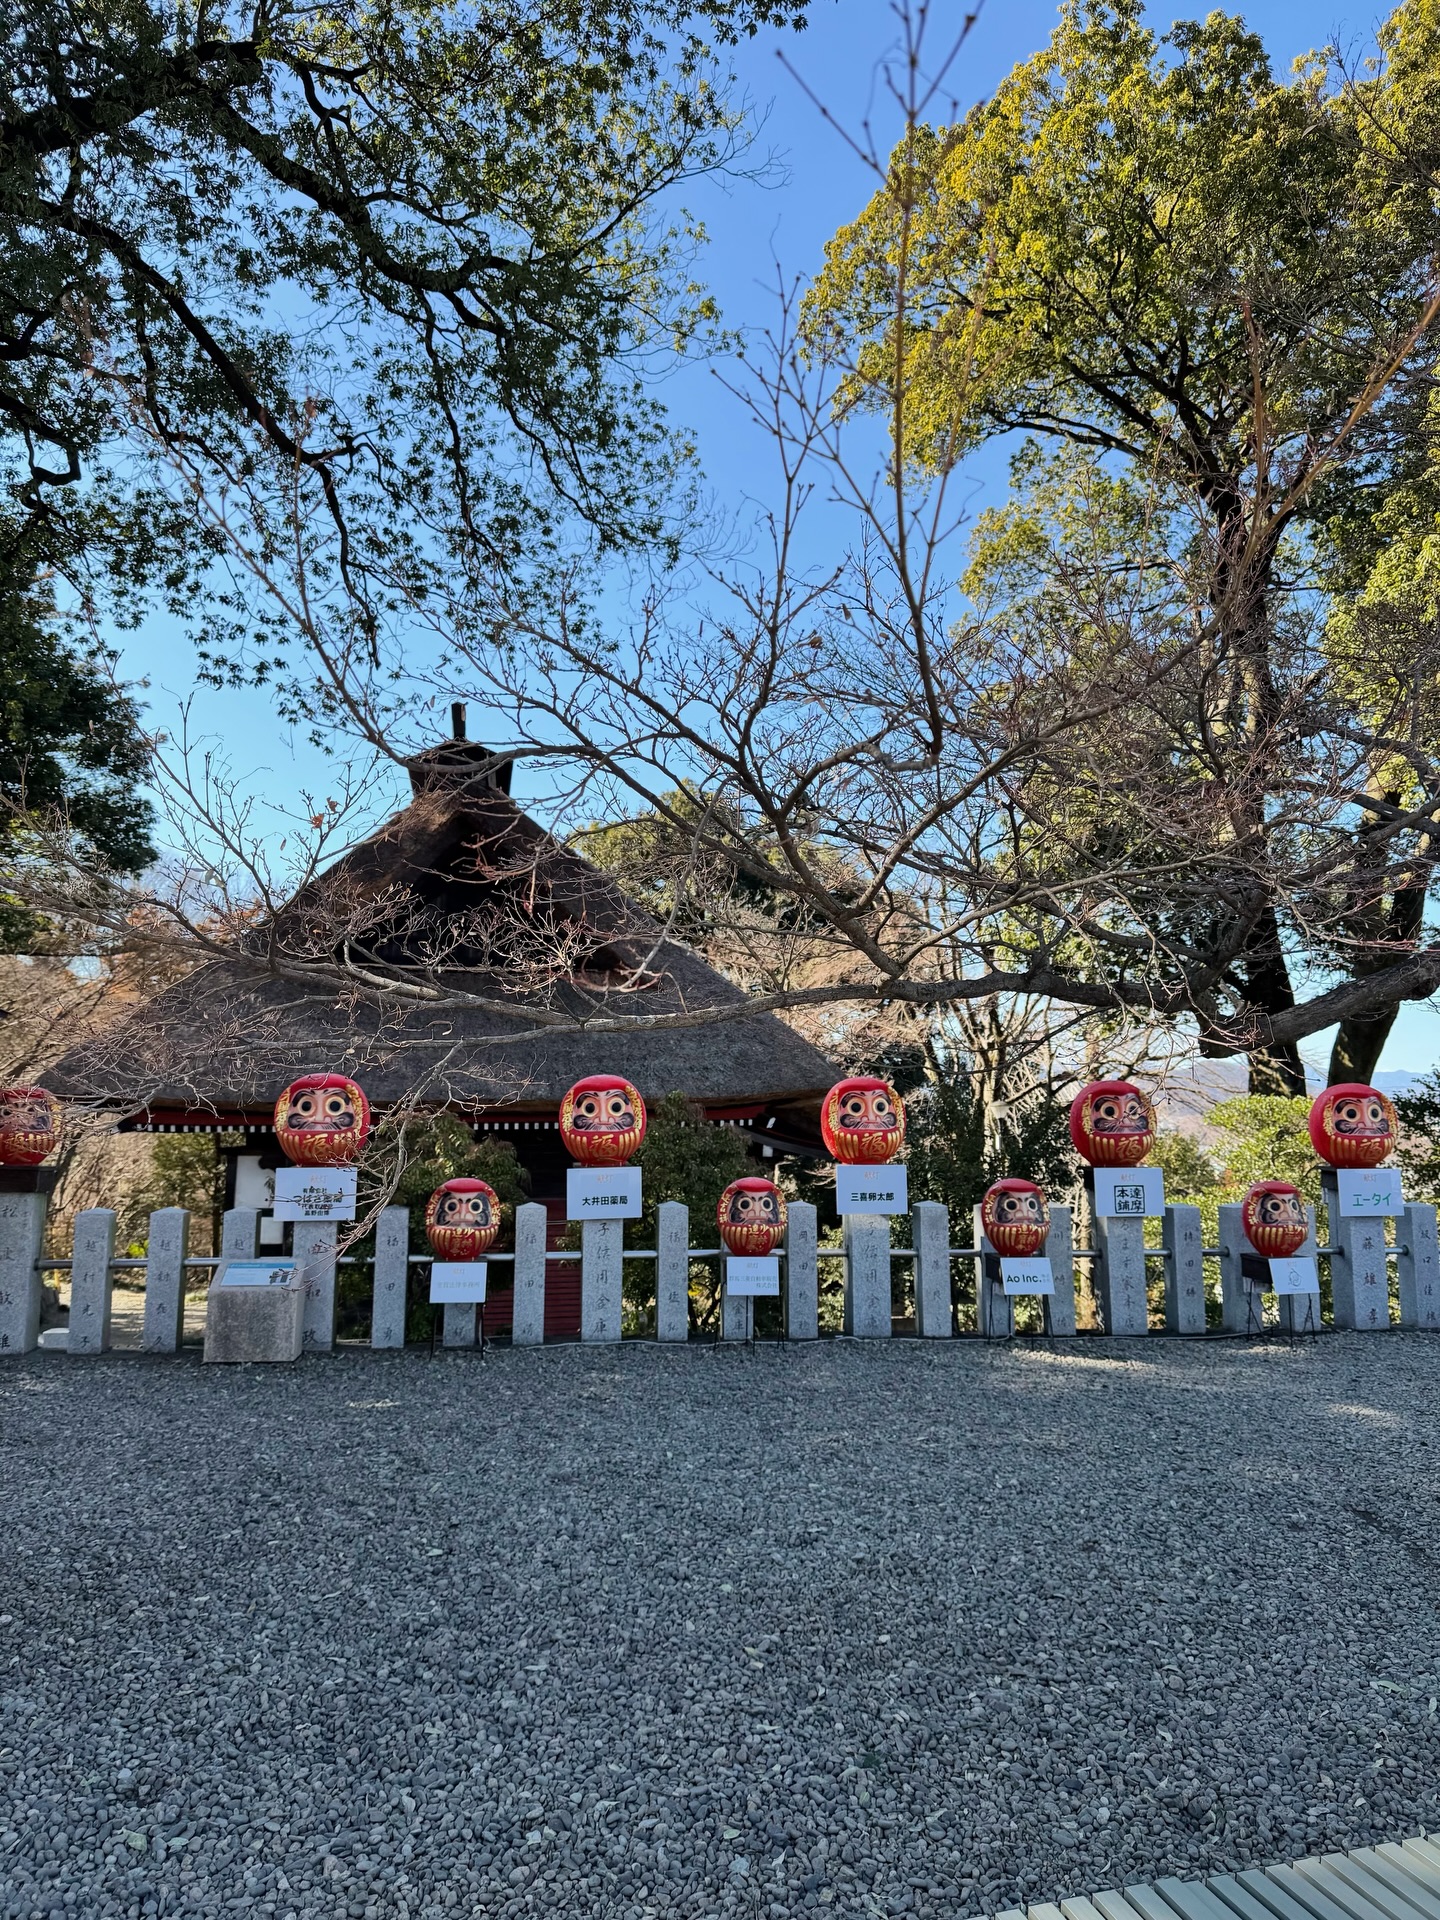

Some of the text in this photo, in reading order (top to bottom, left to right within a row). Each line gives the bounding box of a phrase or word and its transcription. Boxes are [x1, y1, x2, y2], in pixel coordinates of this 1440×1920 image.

[589, 1133, 617, 1157] 福
[860, 1132, 886, 1157] 福
[1117, 1136, 1142, 1158] 福
[1358, 1138, 1382, 1159] 福
[582, 1195, 628, 1206] 大井田薬局
[851, 1192, 894, 1202] 三喜卵太郎
[1353, 1192, 1391, 1206] エータイ
[1006, 1274, 1020, 1283] Ao
[1022, 1274, 1042, 1283] Inc.
